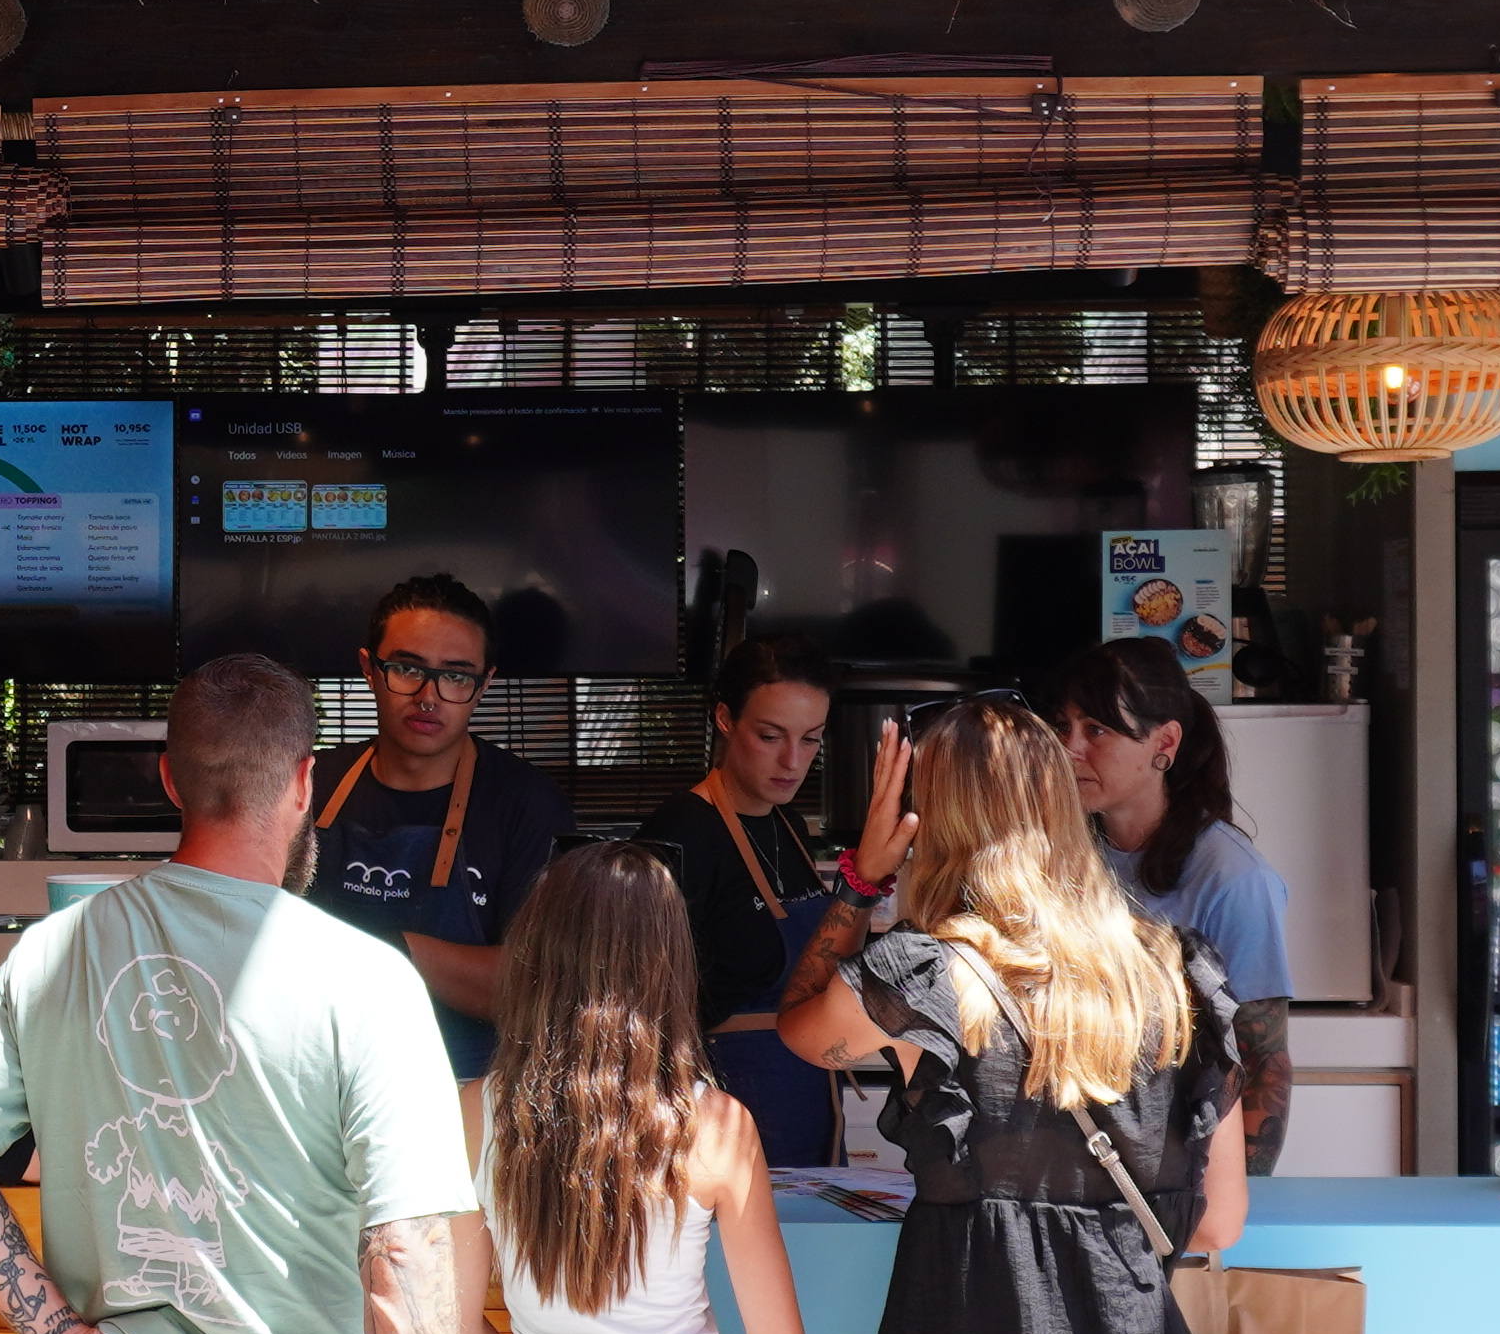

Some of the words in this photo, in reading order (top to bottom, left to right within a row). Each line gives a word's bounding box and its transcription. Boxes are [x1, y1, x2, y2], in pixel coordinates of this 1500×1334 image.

[12, 424, 47, 434] 11,50€
[61, 424, 88, 435] HOT
[114, 423, 151, 435] 10,95€
[228, 422, 272, 436] Unidad
[275, 422, 303, 435] USB
[61, 436, 101, 446] WRAP
[228, 450, 257, 461] Todos
[327, 450, 362, 461] Imagen
[15, 497, 58, 505] TOPPINGS
[224, 534, 269, 544] PANTALLA
[270, 534, 276, 543] 2
[312, 532, 353, 542] PANTALLA
[1113, 539, 1155, 558] AÇAÍ
[1113, 557, 1160, 570] BOWL
[343, 881, 382, 897] mahalo
[383, 888, 411, 903] poké
